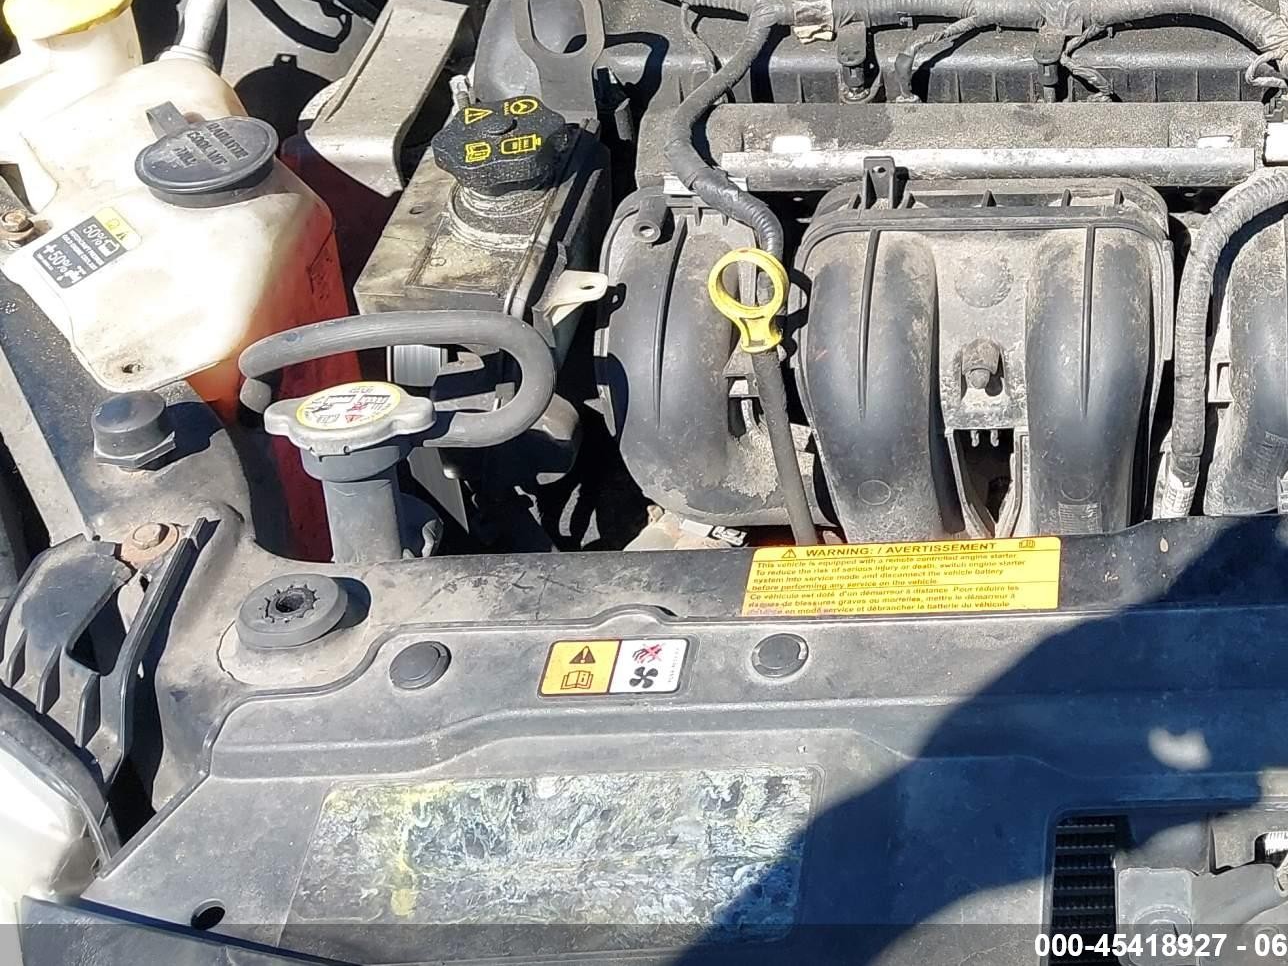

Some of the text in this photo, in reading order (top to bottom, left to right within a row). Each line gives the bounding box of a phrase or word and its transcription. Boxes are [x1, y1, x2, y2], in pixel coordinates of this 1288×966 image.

[82, 223, 108, 247] 50%
[806, 547, 874, 557] WARNING:
[885, 542, 997, 554] AVERTISSEMENT
[818, 559, 857, 568] equipped
[916, 554, 958, 562] controlled
[990, 552, 1017, 560] starter
[875, 565, 899, 573] injury
[968, 561, 997, 569] engine
[753, 577, 784, 585] system
[880, 571, 926, 579] disconnect
[943, 568, 973, 576] vehicle
[974, 568, 1004, 576] battery
[781, 583, 827, 592] performing
[953, 585, 973, 593] Pour
[794, 599, 836, 607] blessures
